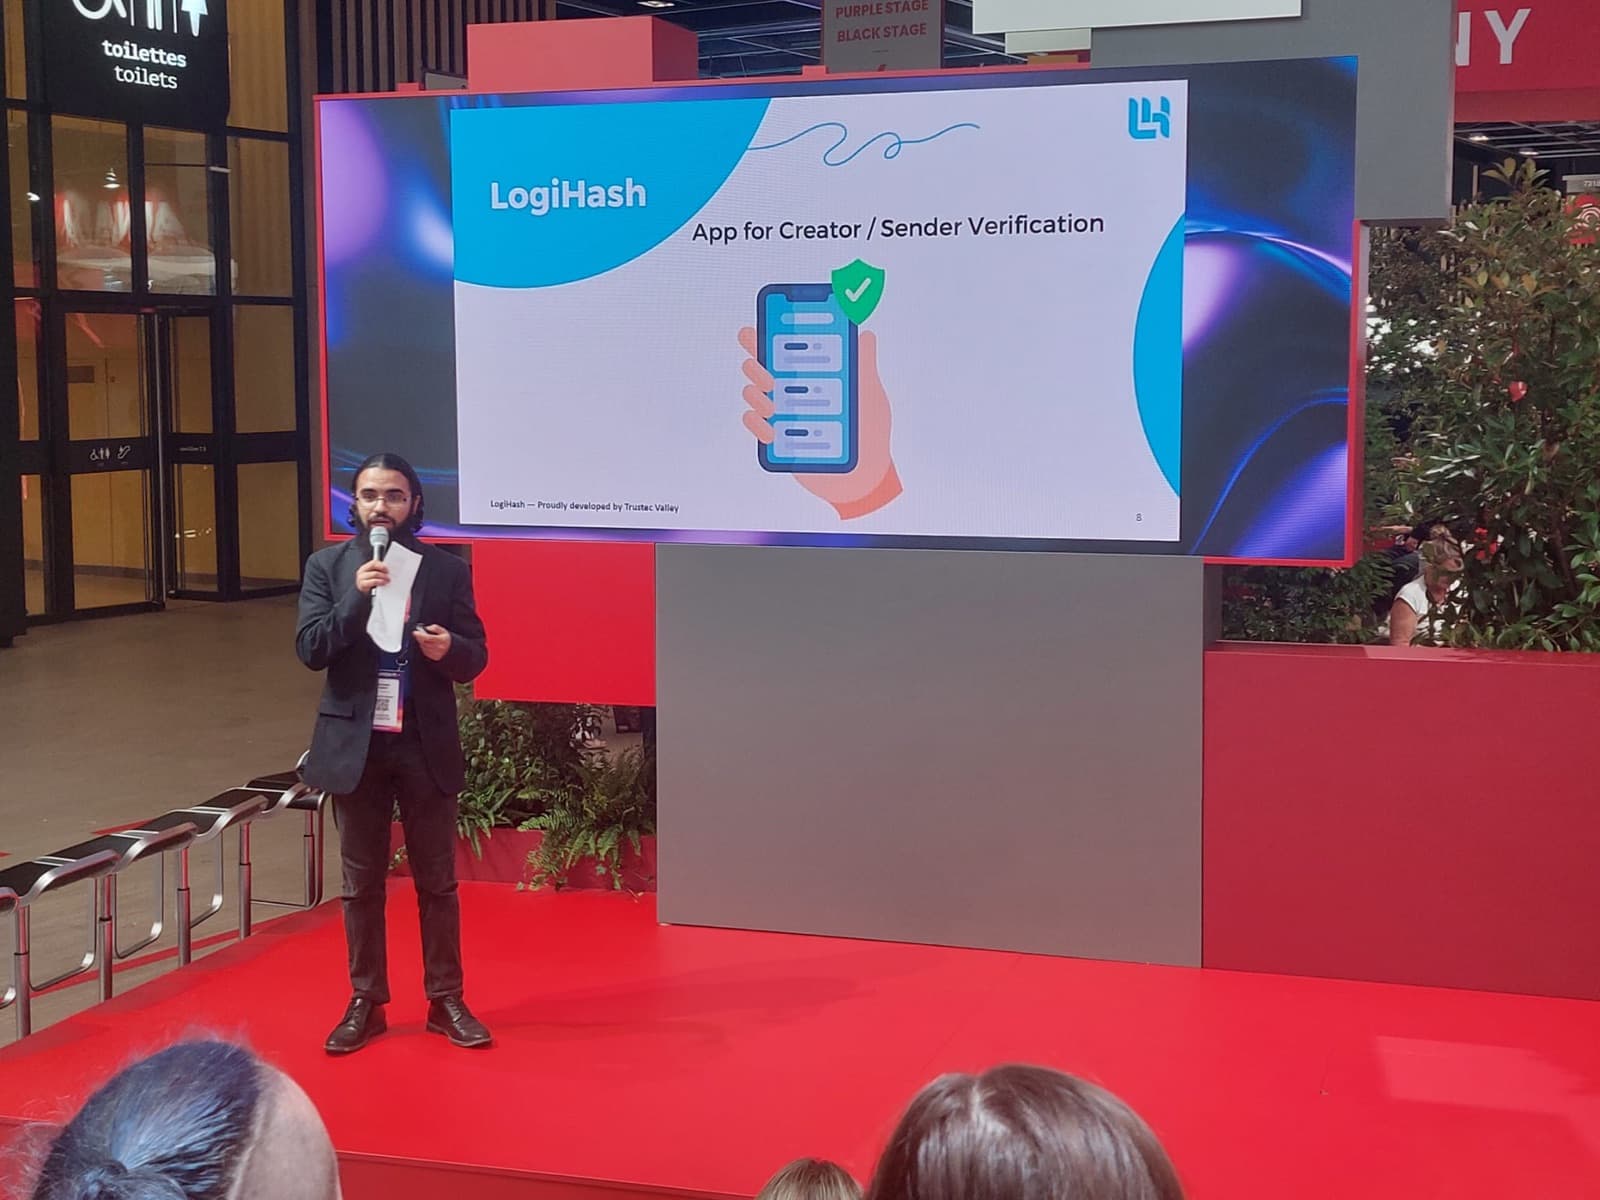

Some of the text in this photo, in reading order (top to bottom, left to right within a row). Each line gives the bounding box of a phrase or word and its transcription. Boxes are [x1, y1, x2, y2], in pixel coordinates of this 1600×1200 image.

[835, 1, 929, 19] PURPLE STAGE
[837, 23, 928, 43] BLACK STAGE
[102, 39, 188, 67] toilettes
[114, 65, 178, 89] toilets
[490, 177, 647, 216] LogiHash
[692, 213, 1105, 245] App for Creator / Sender Verification
[490, 500, 526, 510] LogiHash
[538, 501, 568, 511] Proudly
[570, 501, 611, 512] developed
[613, 502, 622, 512] by
[655, 503, 679, 514] Valley
[1136, 513, 1142, 521] 8
